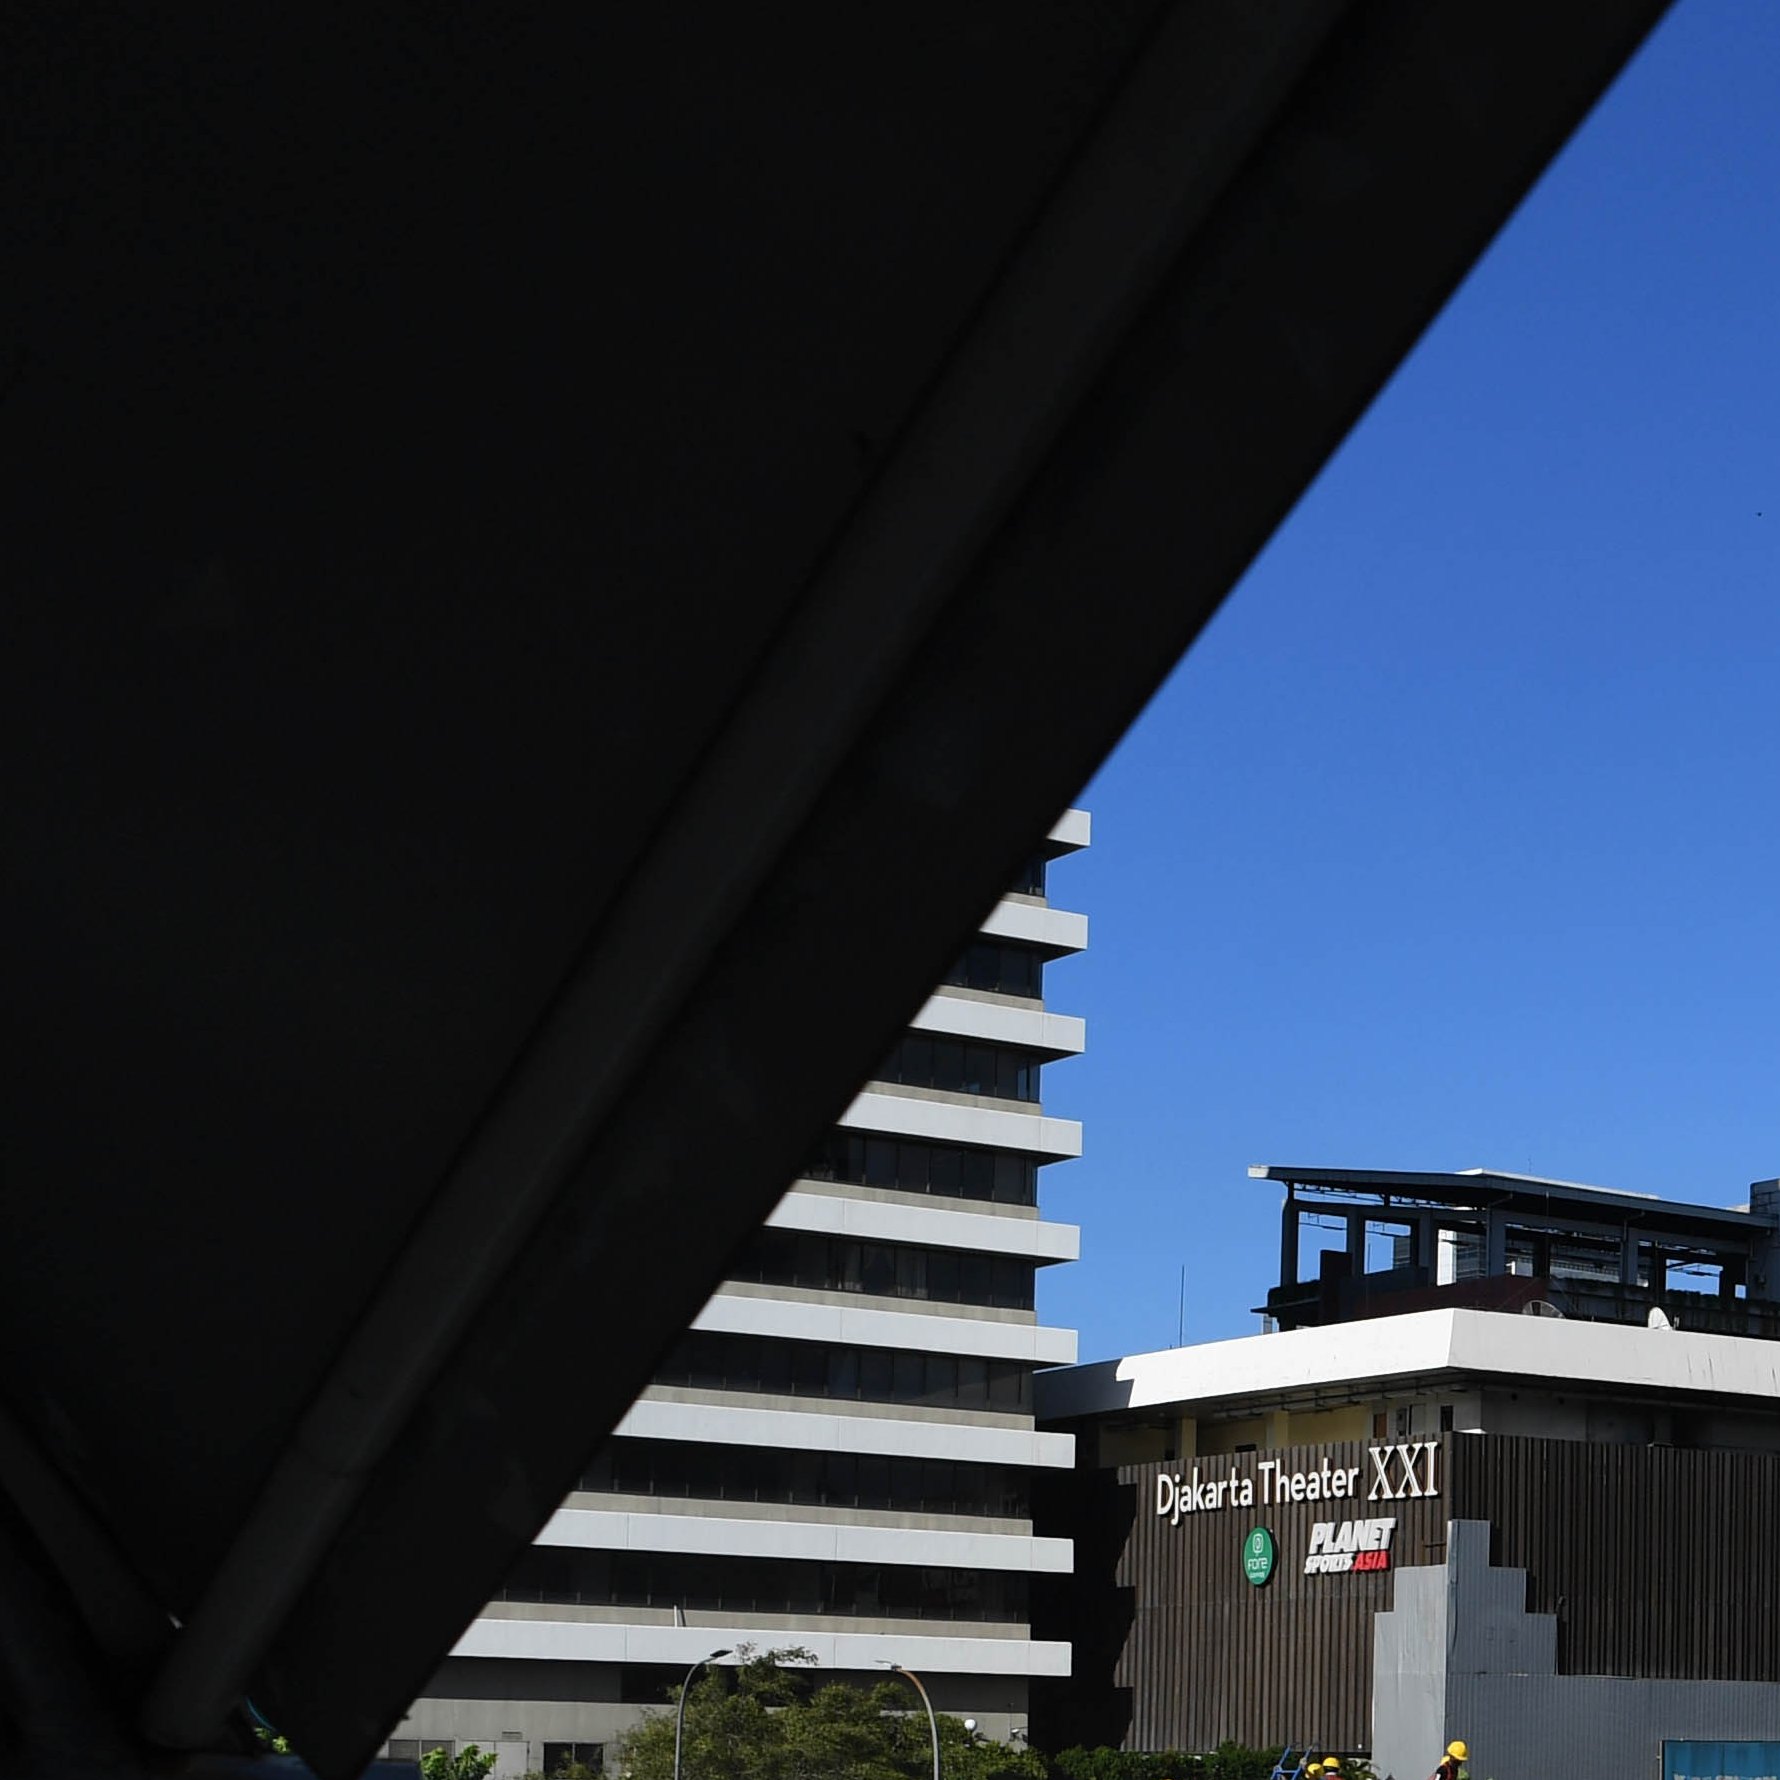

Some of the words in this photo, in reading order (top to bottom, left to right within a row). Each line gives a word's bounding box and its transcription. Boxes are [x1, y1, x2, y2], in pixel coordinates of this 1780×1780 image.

[1156, 1467, 1253, 1526] Djakarta
[1258, 1457, 1360, 1505] Theater
[1367, 1441, 1439, 1501] XXI
[1309, 1518, 1397, 1554] PLANET
